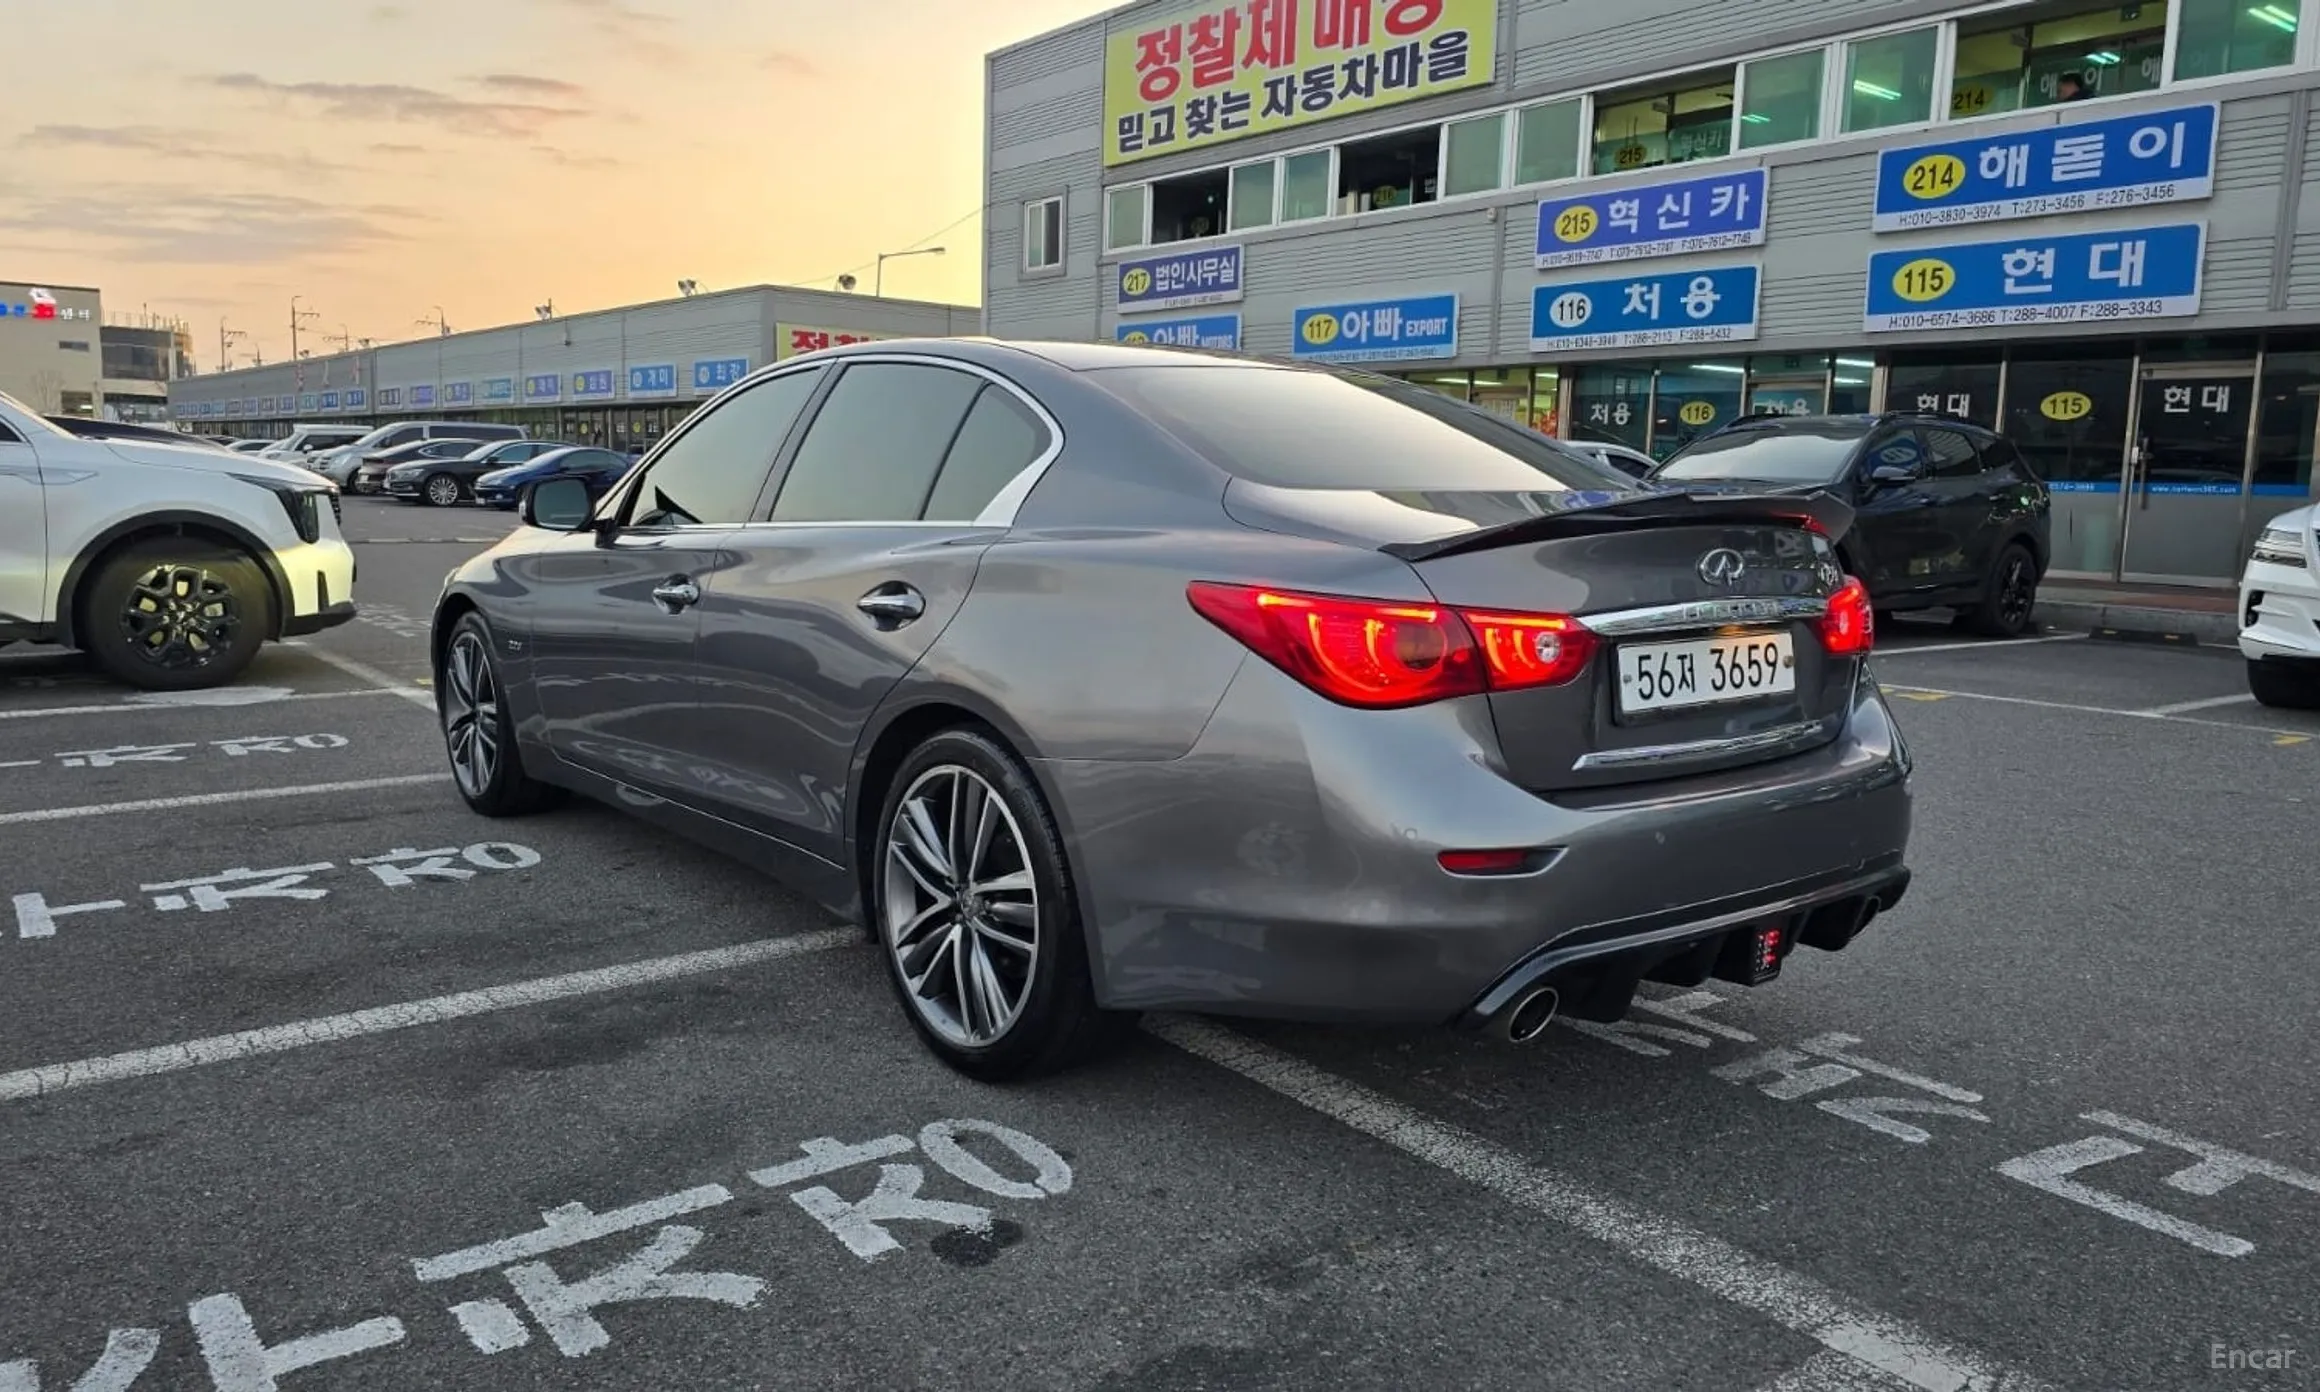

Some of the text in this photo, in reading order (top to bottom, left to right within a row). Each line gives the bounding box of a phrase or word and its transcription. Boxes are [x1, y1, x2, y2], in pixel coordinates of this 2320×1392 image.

[1135, 0, 1298, 101] 정찰제
[1118, 30, 1468, 153] 믿고 찾는 자동차마을
[1953, 90, 1985, 110] 214
[1620, 149, 1642, 163] 215
[1912, 161, 1953, 191] 214
[1608, 184, 1750, 233] 혁신카
[2012, 195, 2085, 215] T:273-3456
[2096, 184, 2175, 205] F:276-3456
[1561, 211, 1591, 234] 215
[1155, 255, 1235, 292] 법인사무실
[1904, 268, 1944, 293] 115
[2002, 240, 2146, 295] 현대
[1126, 273, 1148, 292] 217
[1558, 298, 1587, 322] 116
[1622, 276, 1721, 321] 처용
[2000, 305, 2076, 322] T:288-4007
[2080, 300, 2163, 317] F:288-3343
[1308, 318, 1333, 340] 117
[1343, 308, 1448, 343] 아빠 EXPORT
[1590, 402, 1631, 425] 처용
[2048, 398, 2084, 415] 115
[2163, 385, 2230, 414] 현대
[1637, 642, 1779, 701] 56저 3659
